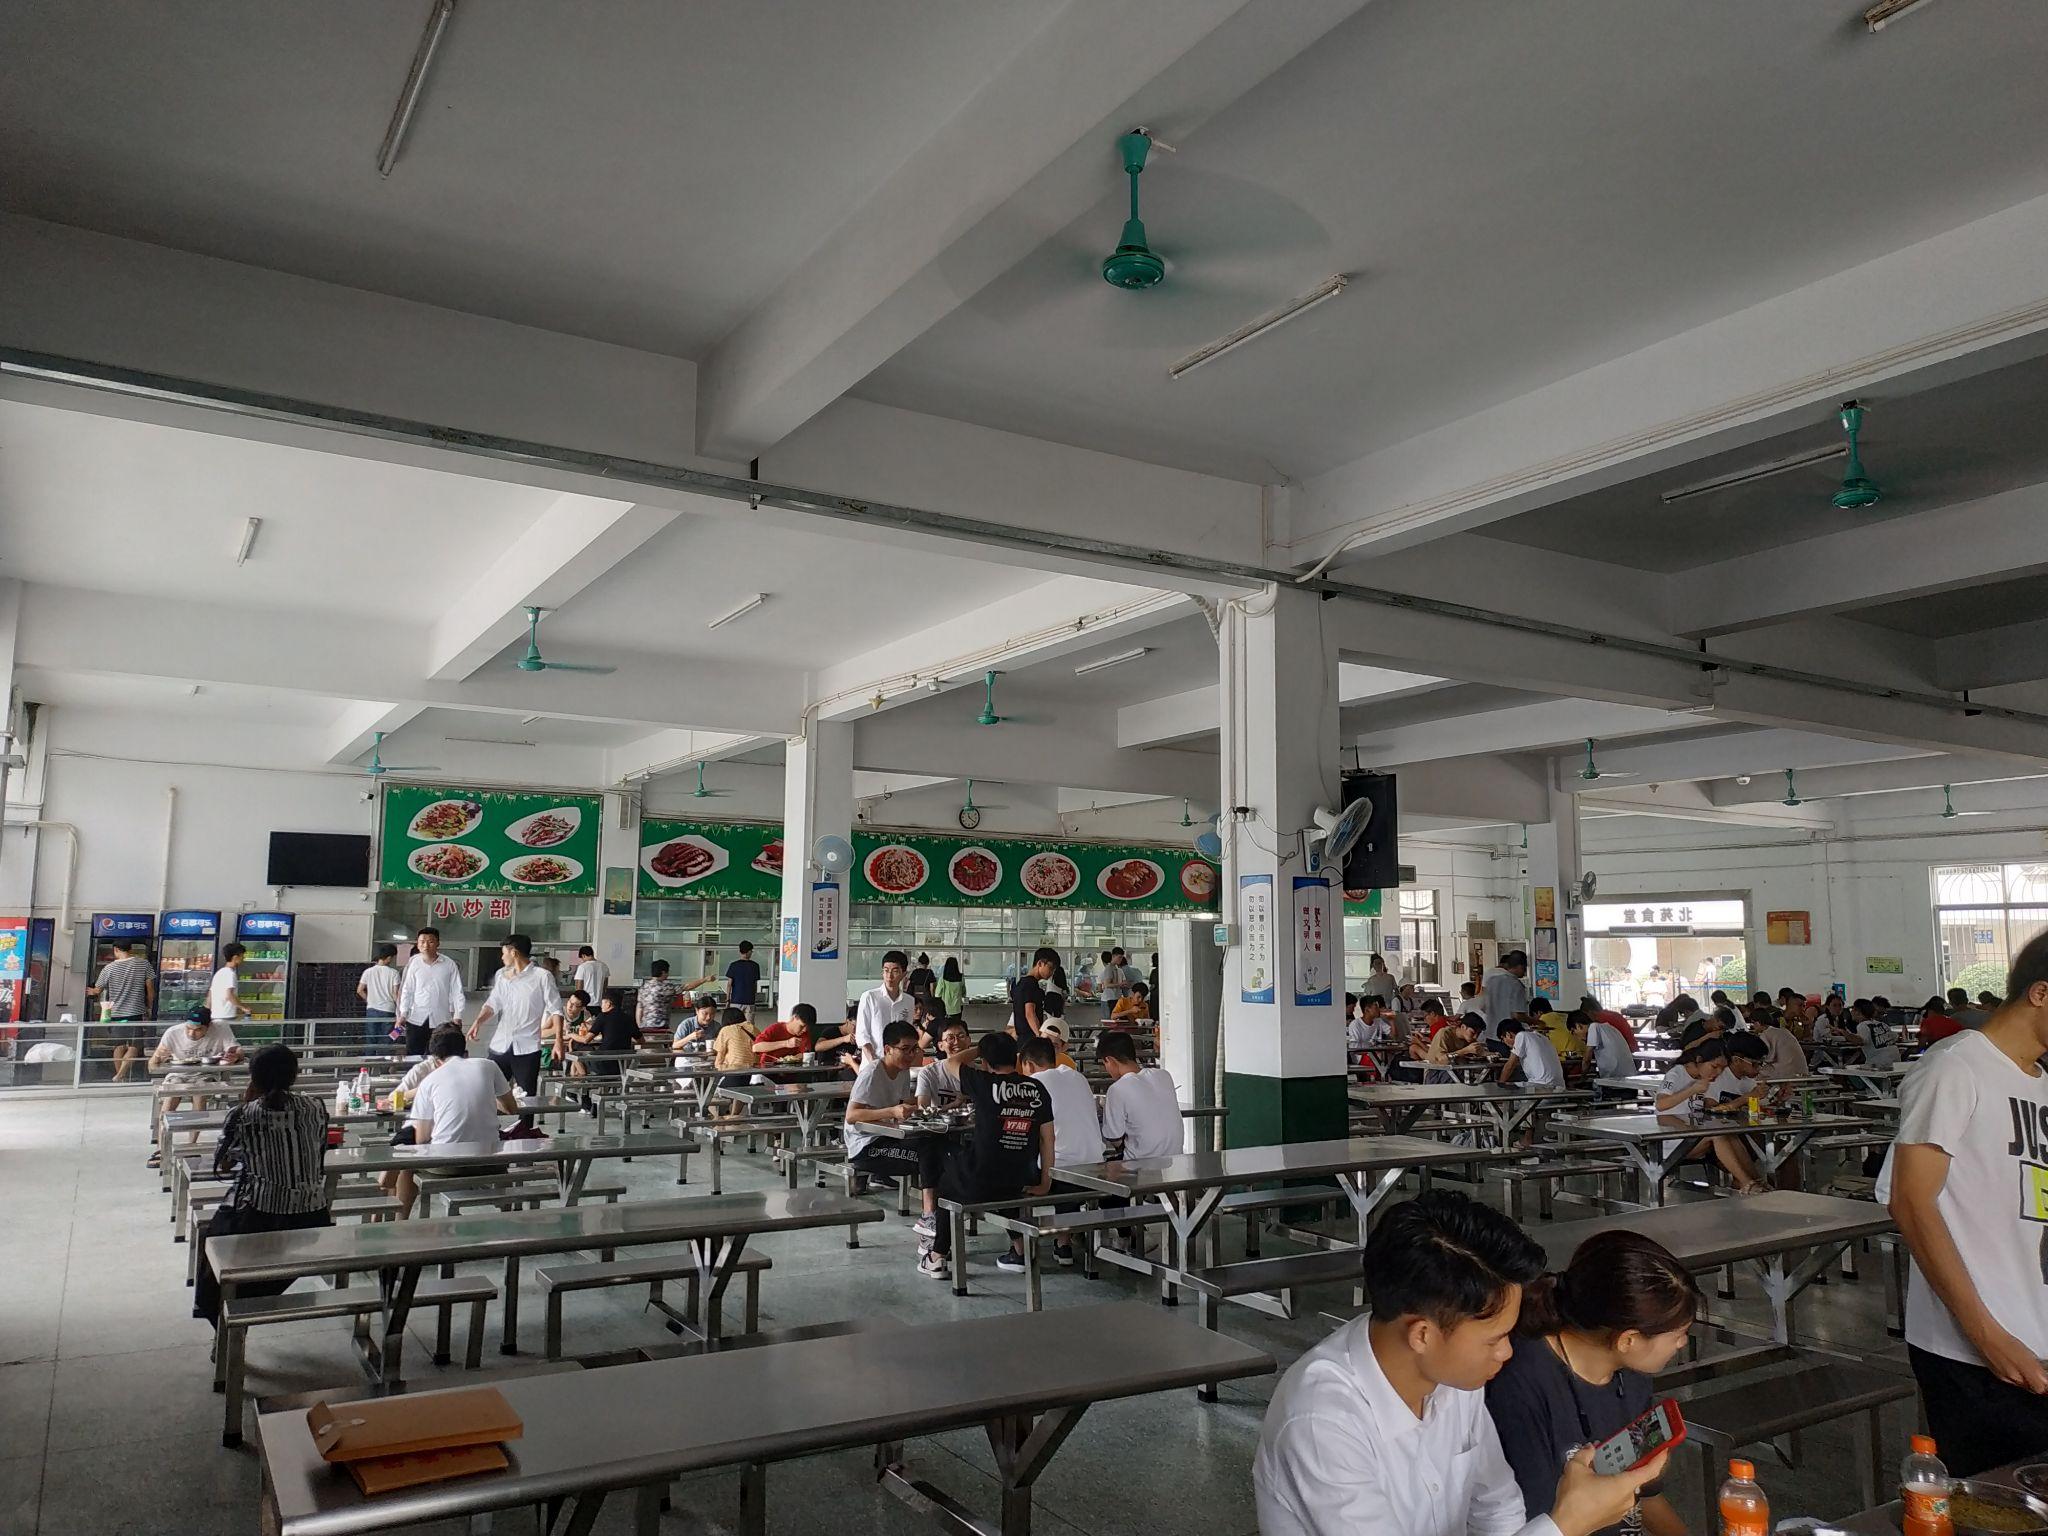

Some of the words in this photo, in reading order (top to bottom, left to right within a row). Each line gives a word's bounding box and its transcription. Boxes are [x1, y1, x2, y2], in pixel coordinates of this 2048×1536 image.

[434, 898, 511, 919] 小炒部
[992, 1081, 1042, 1108] Nothing
